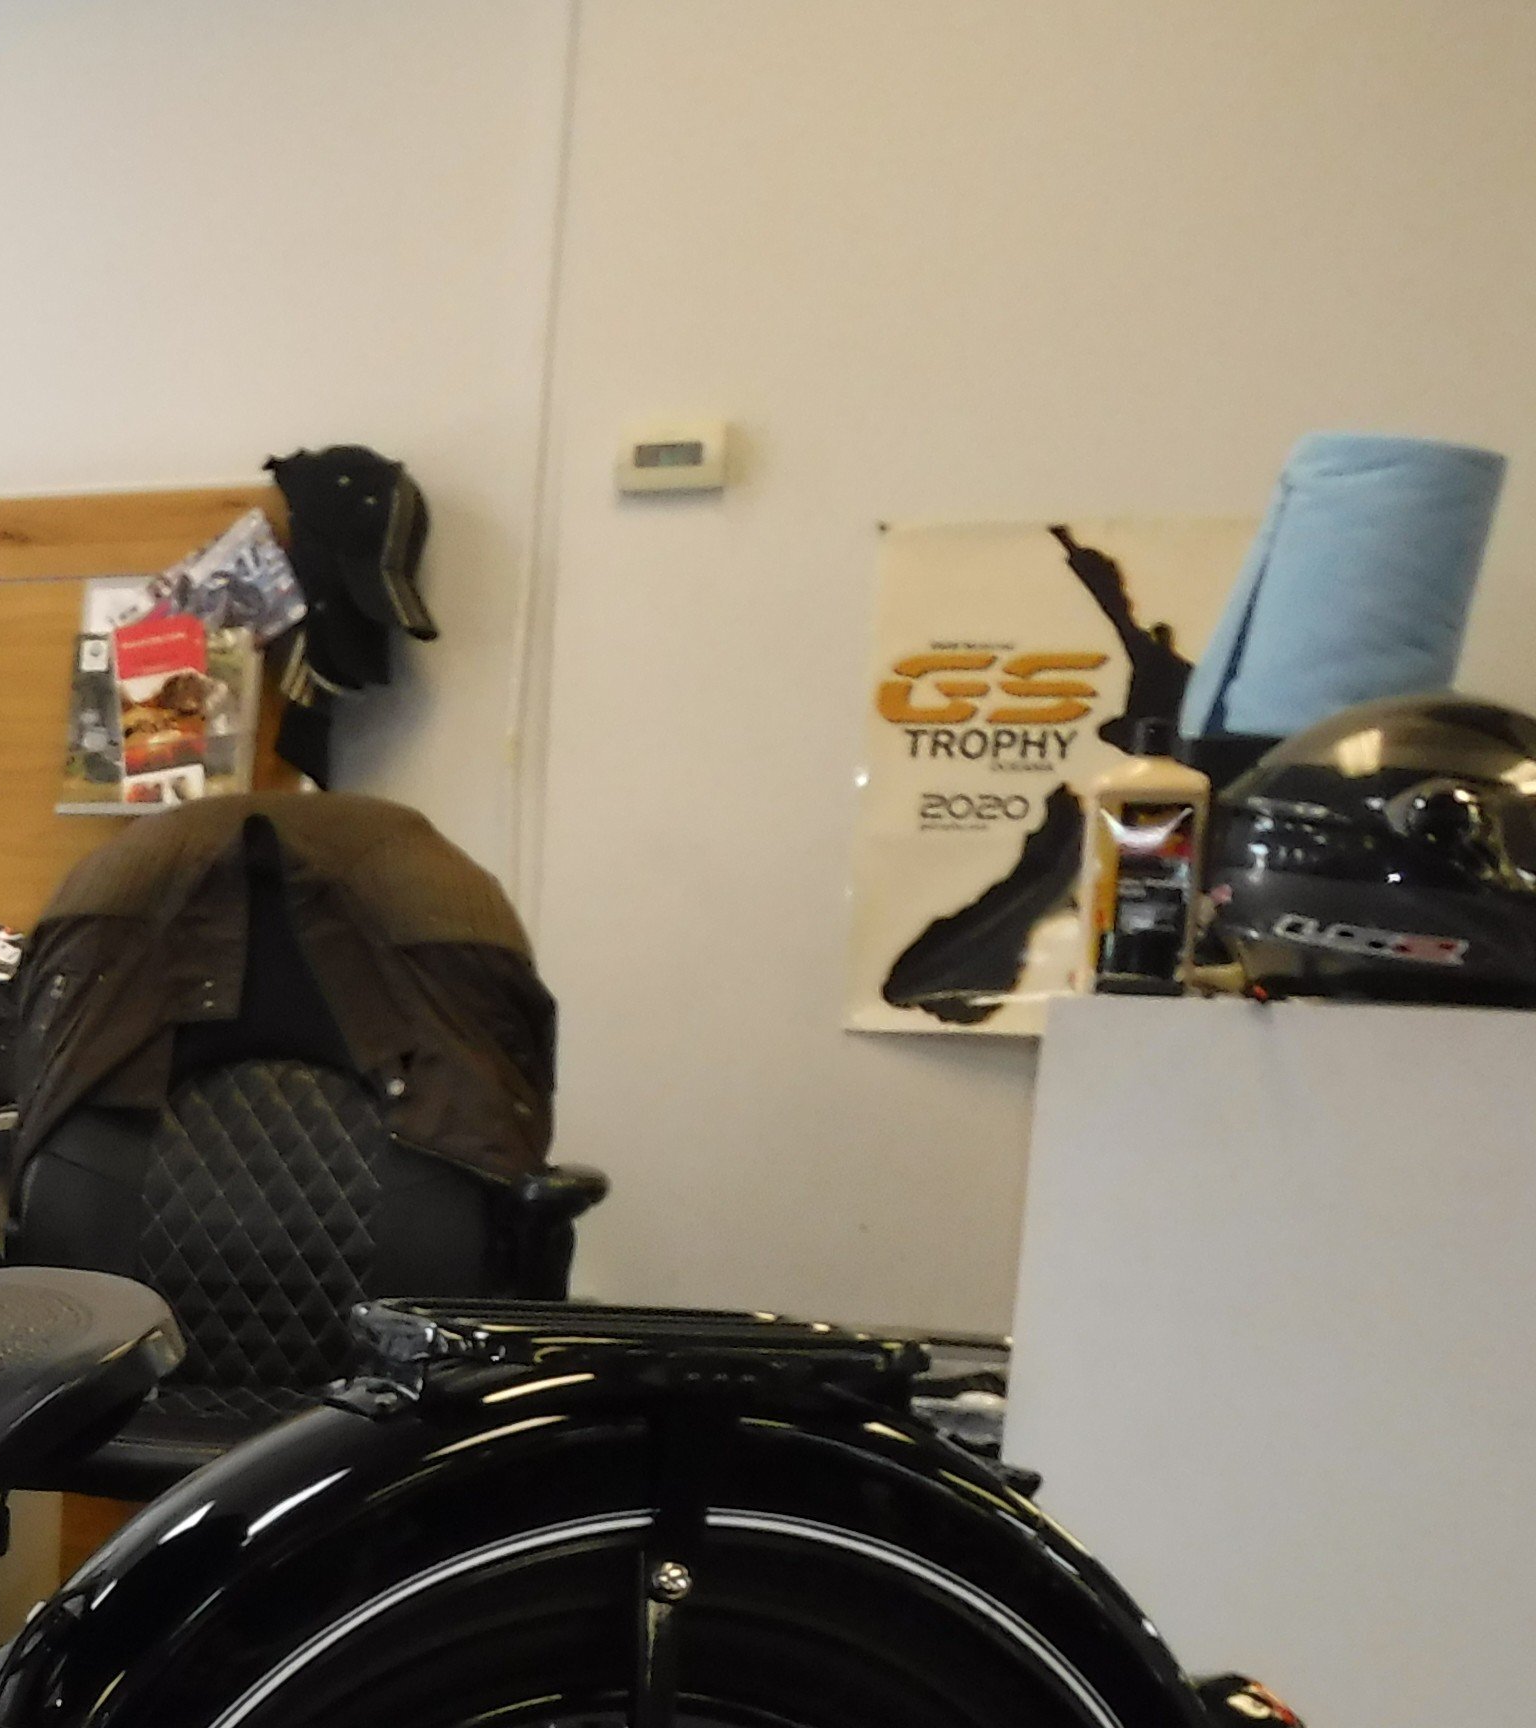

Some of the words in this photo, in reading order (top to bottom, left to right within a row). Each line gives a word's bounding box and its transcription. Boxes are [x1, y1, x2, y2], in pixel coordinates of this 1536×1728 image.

[877, 654, 1110, 723] GS
[905, 728, 1078, 760] TROPHY
[921, 793, 1030, 820] 2020
